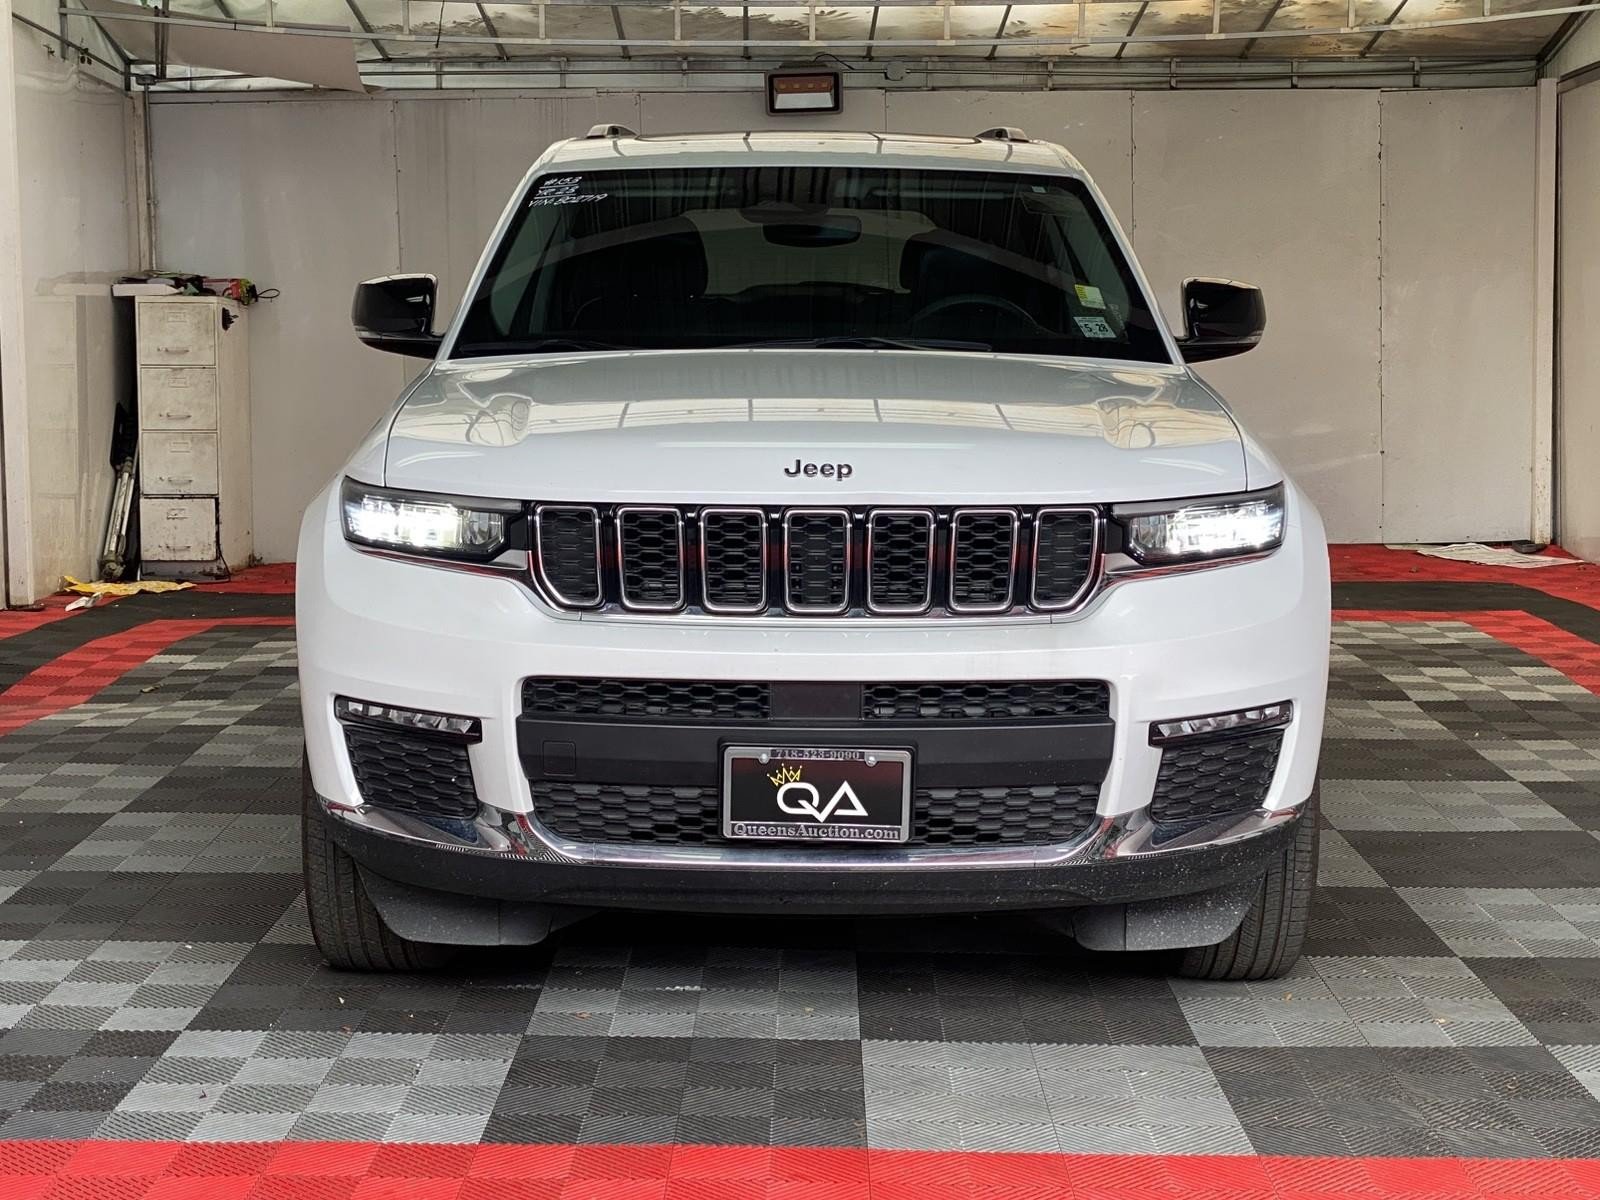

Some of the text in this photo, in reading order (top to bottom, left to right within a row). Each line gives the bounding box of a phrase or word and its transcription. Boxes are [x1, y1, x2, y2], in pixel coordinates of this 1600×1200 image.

[784, 459, 853, 481] Jeep
[776, 749, 860, 760] 718-523-9090
[776, 780, 869, 823] QA
[733, 822, 900, 840] QueensAuction.com
